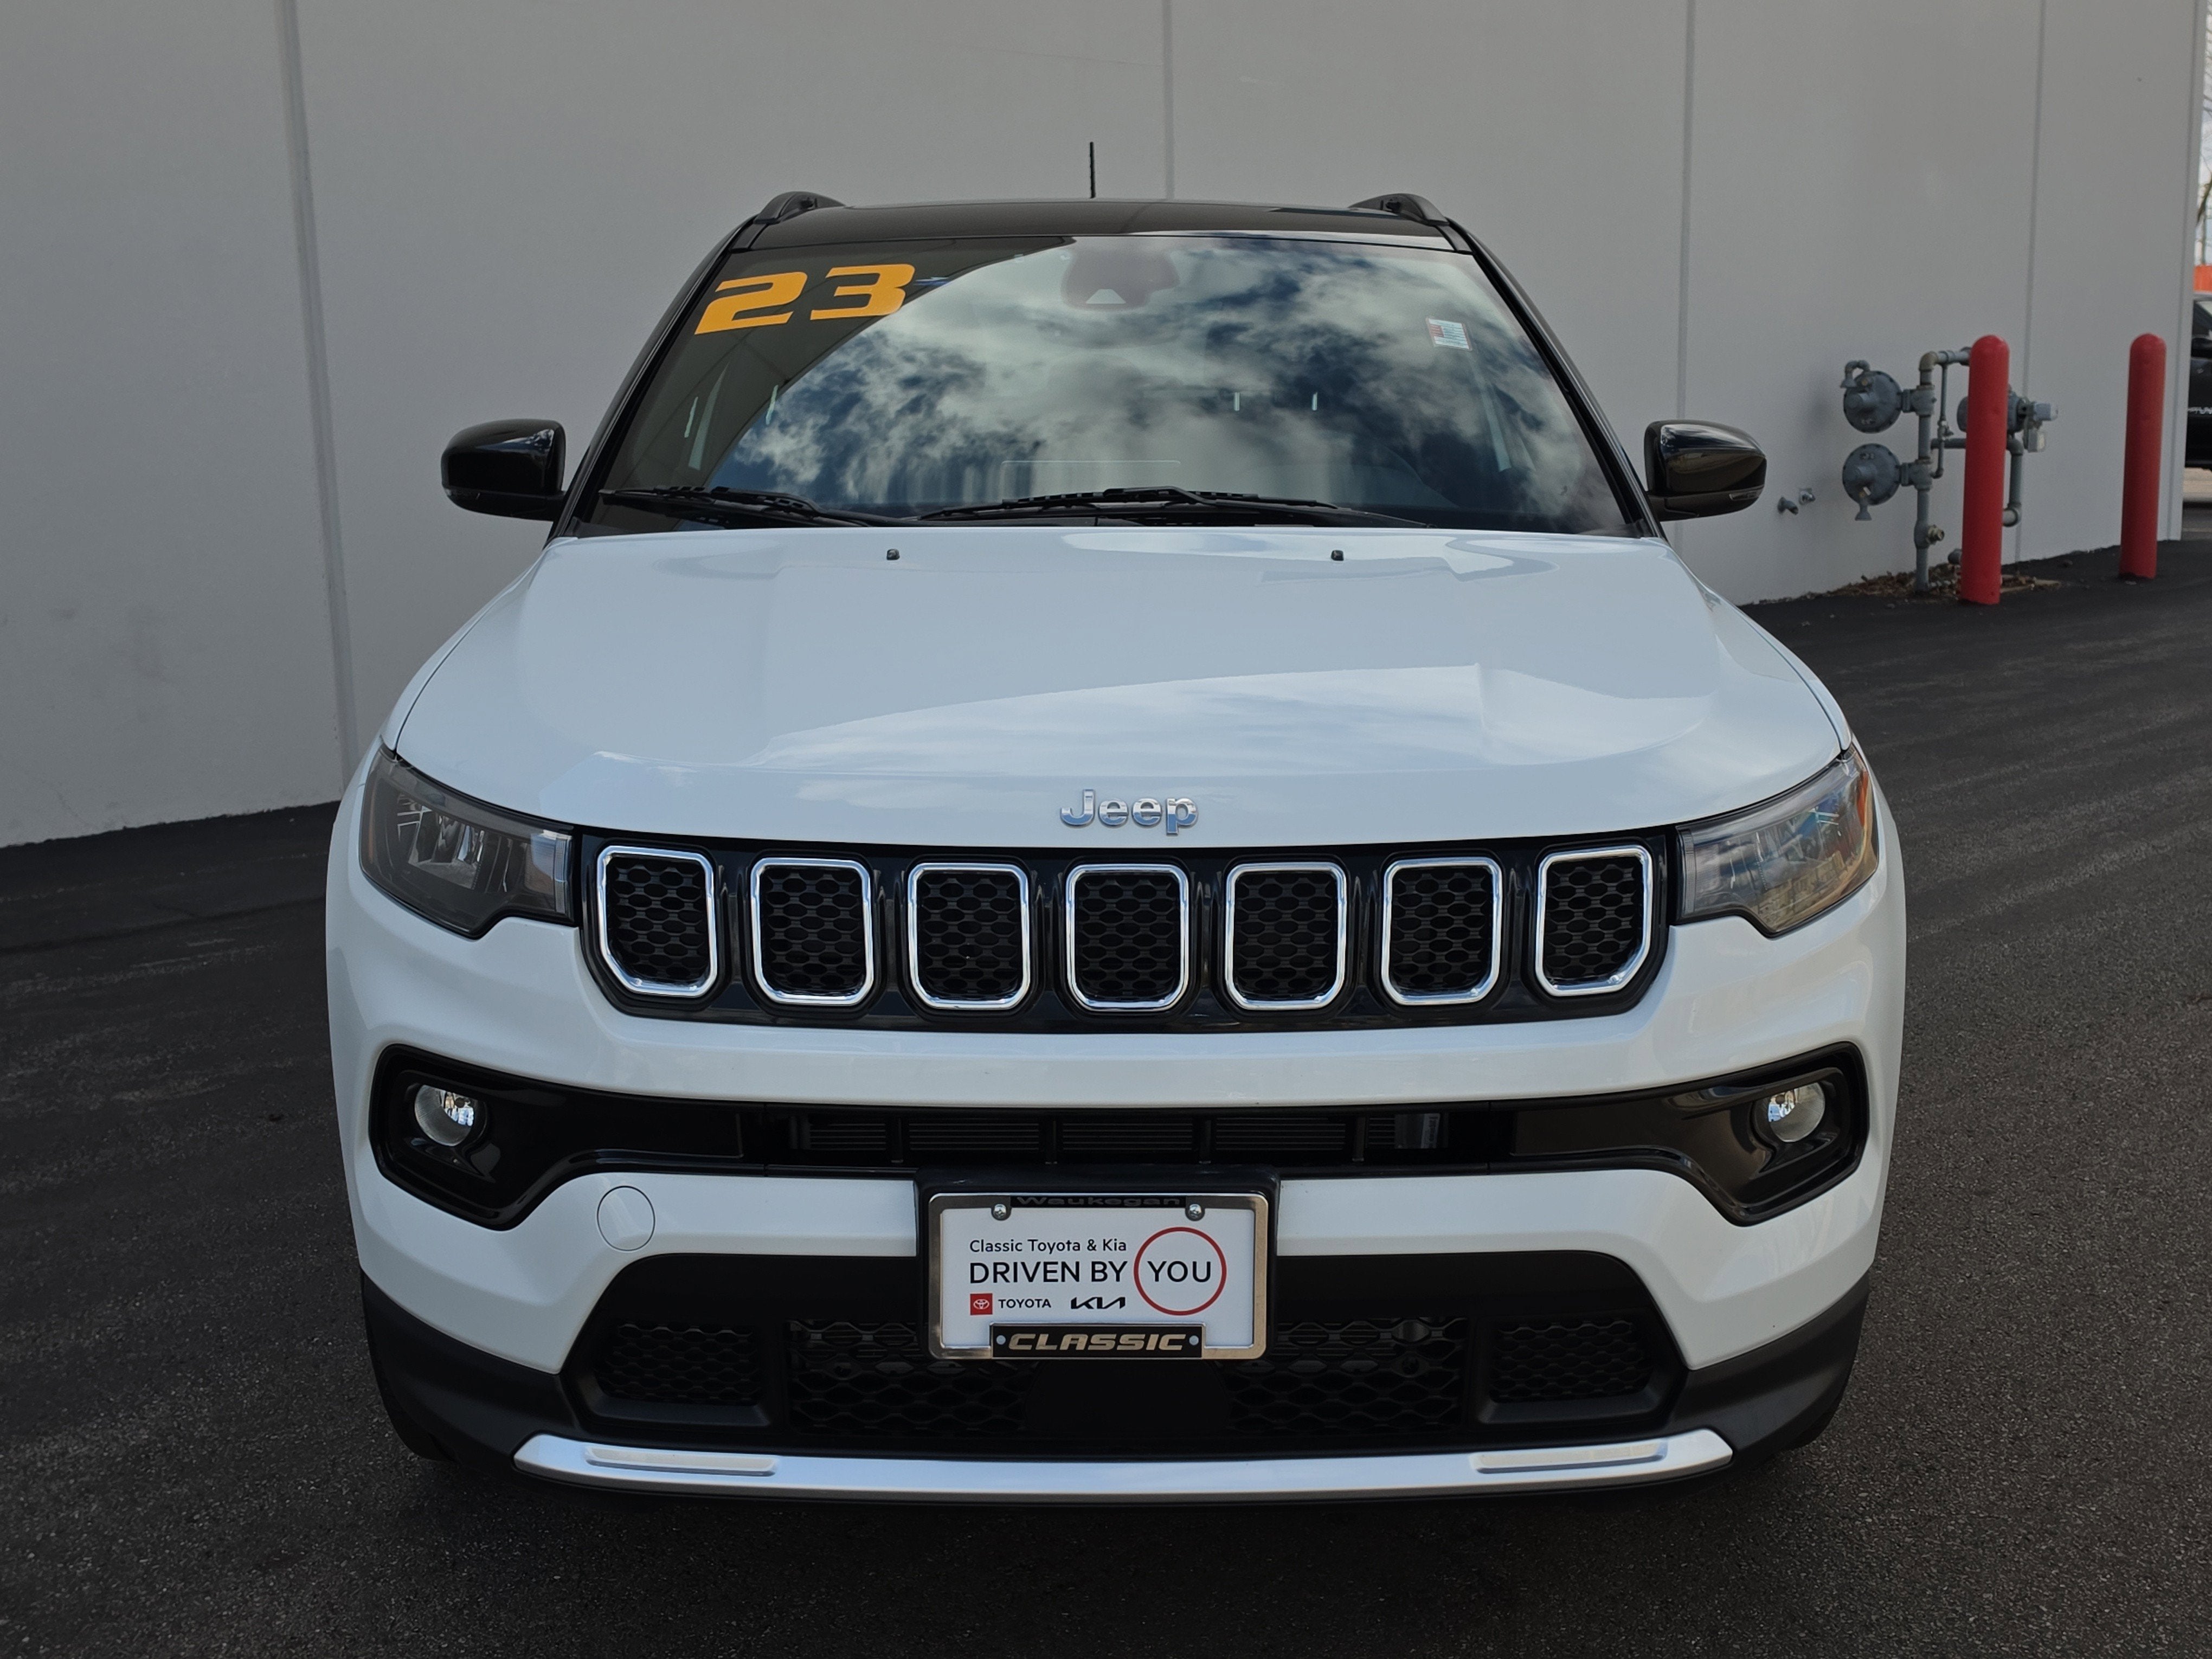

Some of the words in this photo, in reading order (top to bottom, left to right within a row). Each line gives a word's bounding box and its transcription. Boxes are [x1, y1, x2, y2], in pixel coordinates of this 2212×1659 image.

[695, 263, 915, 335] 23
[1060, 789, 1199, 836] Jeep
[1017, 1197, 1180, 1207] Waukegan
[970, 1239, 1023, 1252] Classic
[1027, 1239, 1081, 1254] Toyota
[1086, 1239, 1097, 1251] &
[1103, 1238, 1127, 1251] Kia
[970, 1261, 1080, 1284] DRIVEN
[1091, 1261, 1128, 1282] BY
[1148, 1261, 1212, 1283] YOU
[998, 1298, 1052, 1309] TOYOTA
[1070, 1296, 1126, 1309] KIA
[1008, 1334, 1186, 1351] CLASSIC
